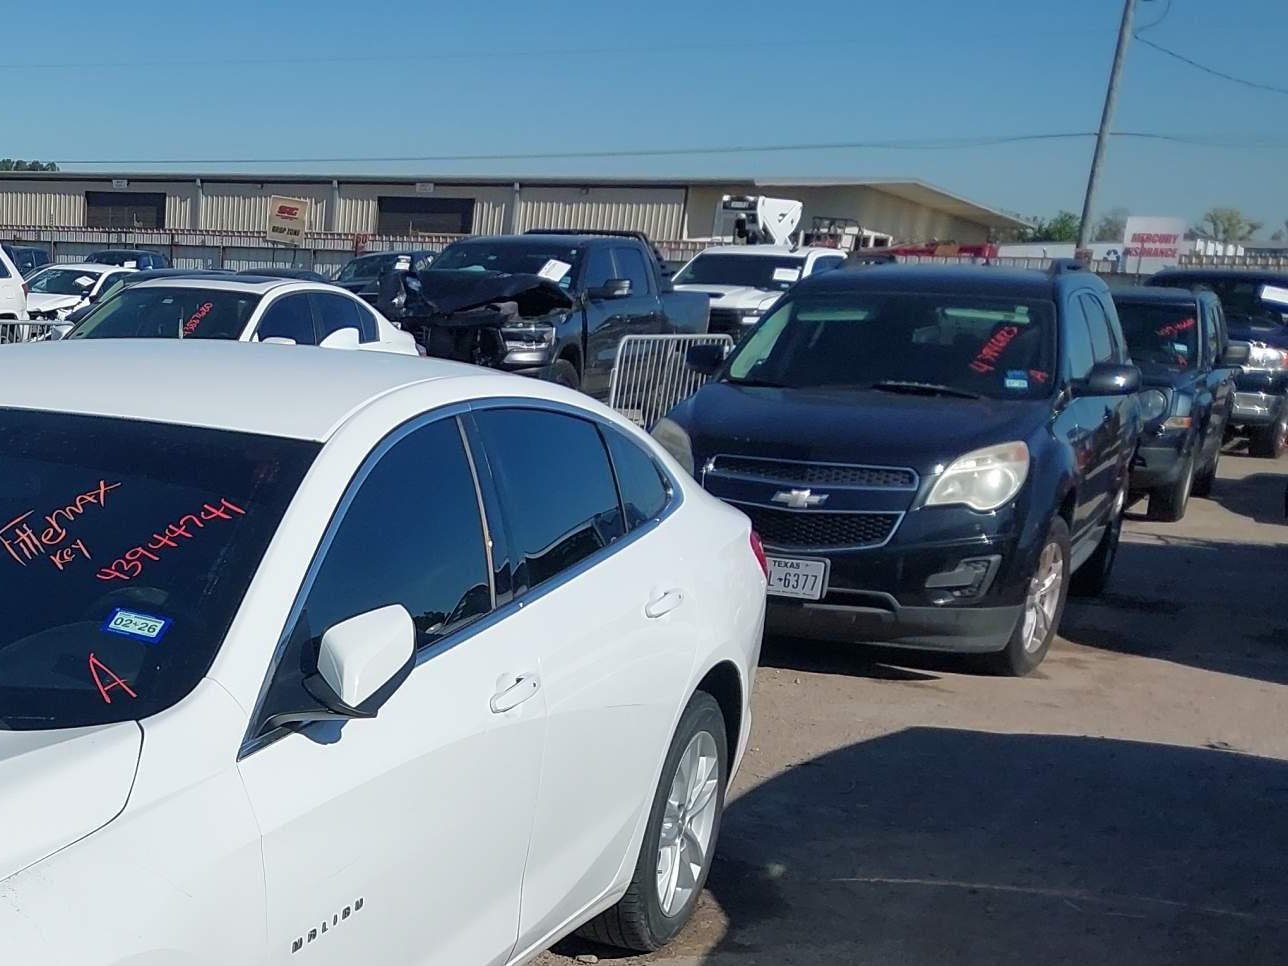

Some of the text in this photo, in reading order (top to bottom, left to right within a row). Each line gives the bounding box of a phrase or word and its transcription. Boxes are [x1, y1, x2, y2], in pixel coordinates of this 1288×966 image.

[1122, 247, 1178, 258] INSURANCE
[1130, 232, 1178, 244] MERCURY
[96, 498, 247, 582] 43944741
[772, 559, 801, 570] TEXAS
[87, 651, 138, 705] A
[291, 897, 364, 954] MALIBU
